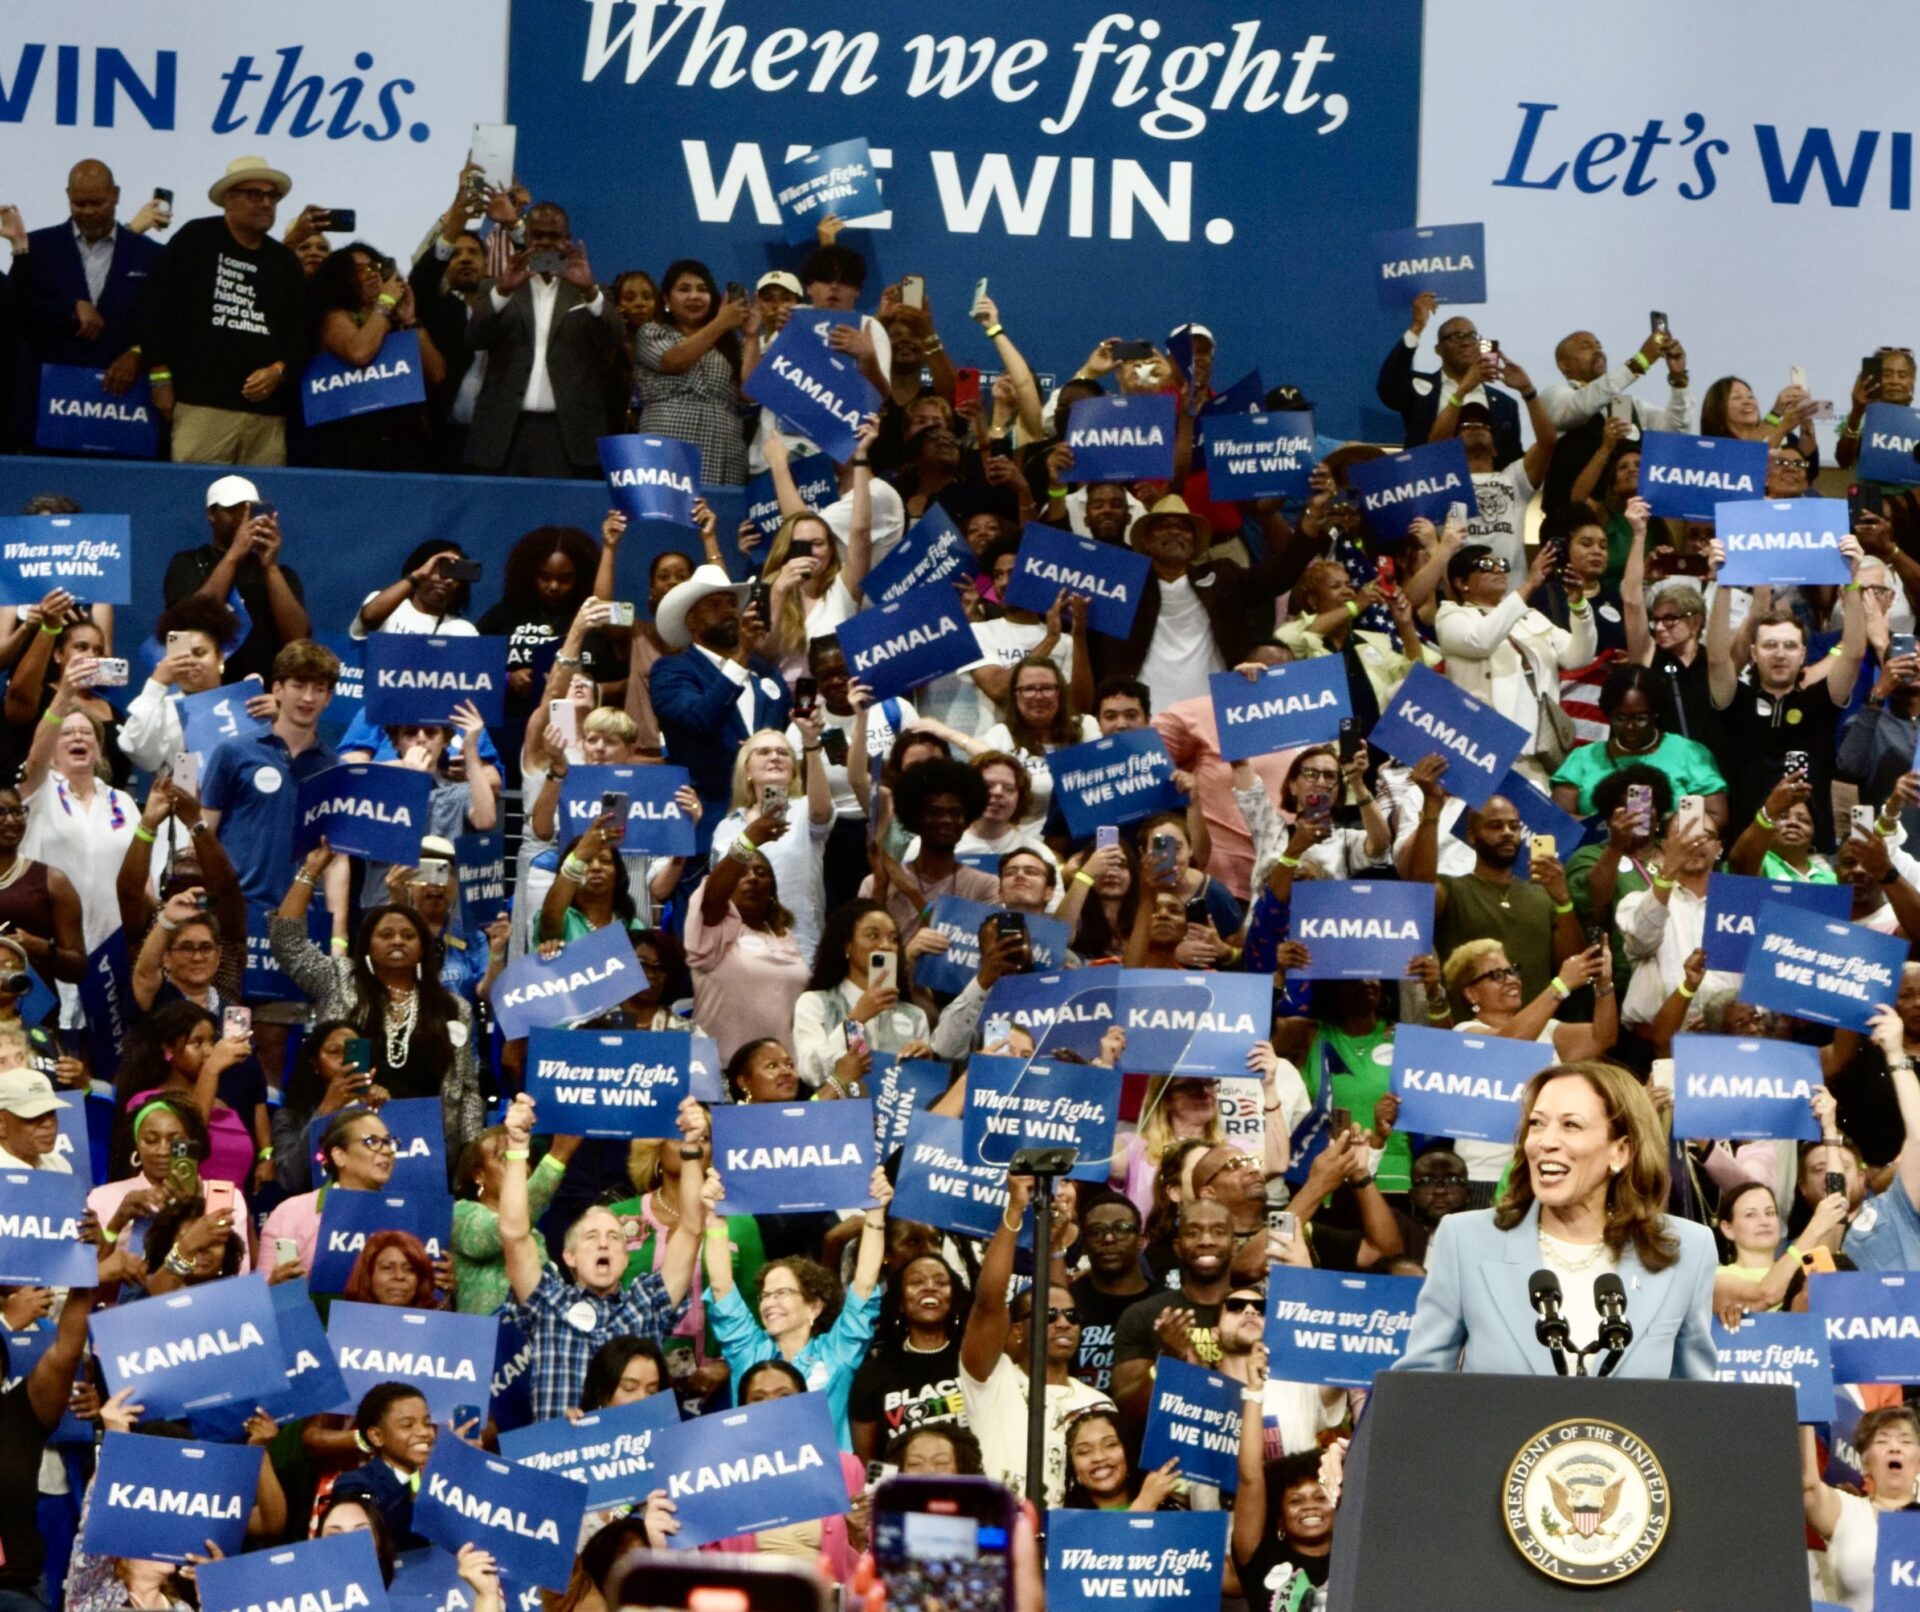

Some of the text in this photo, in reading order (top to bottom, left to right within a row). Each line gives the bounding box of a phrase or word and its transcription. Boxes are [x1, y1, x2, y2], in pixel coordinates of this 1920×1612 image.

[581, 0, 1349, 140] When we fight,
[211, 45, 430, 143] this.
[793, 184, 858, 215] WE WIN.
[930, 150, 1235, 245] WIN.
[217, 263, 245, 281] here
[224, 257, 258, 273] came
[1381, 254, 1475, 280] KAMALA
[216, 275, 234, 290] for
[214, 287, 254, 309] history
[212, 314, 271, 336] of culture.
[213, 303, 265, 322] and a lot
[310, 359, 411, 395] KAMALA
[770, 354, 864, 433] KAMALA
[49, 398, 149, 424] KAMALA
[1069, 425, 1164, 448] KAMALA
[1212, 435, 1312, 457] When we fight,
[1227, 456, 1302, 475] WE WIN.
[1648, 464, 1754, 493] KAMALA
[610, 468, 693, 495] KAMALA
[1365, 472, 1462, 514] KAMALA
[3, 541, 122, 561] When we fight,
[1727, 530, 1838, 552] KAMALA
[19, 562, 104, 578] WE WIN.
[1024, 557, 1128, 603] KAMALA
[515, 622, 551, 635] she
[853, 615, 958, 671] KAMALA
[338, 662, 364, 680] hen
[377, 669, 493, 691] KAMALA
[1225, 689, 1339, 725] KAMALA
[1398, 700, 1498, 775] KAMALA
[1062, 764, 1104, 792] When
[1106, 763, 1127, 780] we
[1126, 750, 1167, 777] fight,
[1081, 773, 1160, 806] WE WIN.
[303, 797, 412, 828] KAMALA
[569, 800, 682, 821] KAALA
[1300, 918, 1420, 939] KAMALA
[947, 948, 981, 968] WE
[1762, 933, 1893, 987] When we fight,
[503, 957, 625, 1008] KAMALA
[1775, 961, 1869, 1001] WE WIN.
[991, 1001, 1113, 1029] KAMALA
[1129, 1008, 1255, 1034] KAMALA
[537, 1060, 595, 1081] When
[597, 1066, 625, 1082] we
[624, 1063, 679, 1088] fight,
[1687, 1073, 1812, 1099] KAMALA
[555, 1087, 657, 1106] WE WIN.
[973, 1089, 1105, 1125] When we fight,
[986, 1115, 1081, 1143] WE WIN.
[727, 1143, 862, 1171] KAMALA
[928, 1173, 969, 1198] WE
[1276, 1300, 1336, 1325] When
[1337, 1311, 1367, 1328] we
[117, 1320, 264, 1379] KAMALA
[1294, 1329, 1400, 1356] WE WIN.
[1735, 1349, 1762, 1364] we
[1761, 1344, 1819, 1369] fight,
[340, 1346, 476, 1382] KAMALA
[1159, 1392, 1203, 1420] When
[1202, 1409, 1224, 1426] we
[1169, 1421, 1200, 1446] WE
[581, 1442, 611, 1461] we
[590, 1456, 655, 1481] WIN.
[668, 1443, 823, 1500] KAMALA
[109, 1482, 242, 1519] KAMALA
[429, 1473, 560, 1545] KAMALA
[1508, 1426, 1665, 1573] VICE PRESIDENT OF THE UNITED STATES
[1061, 1548, 1212, 1576] When we fight,
[1081, 1576, 1191, 1598] WE WIN.
